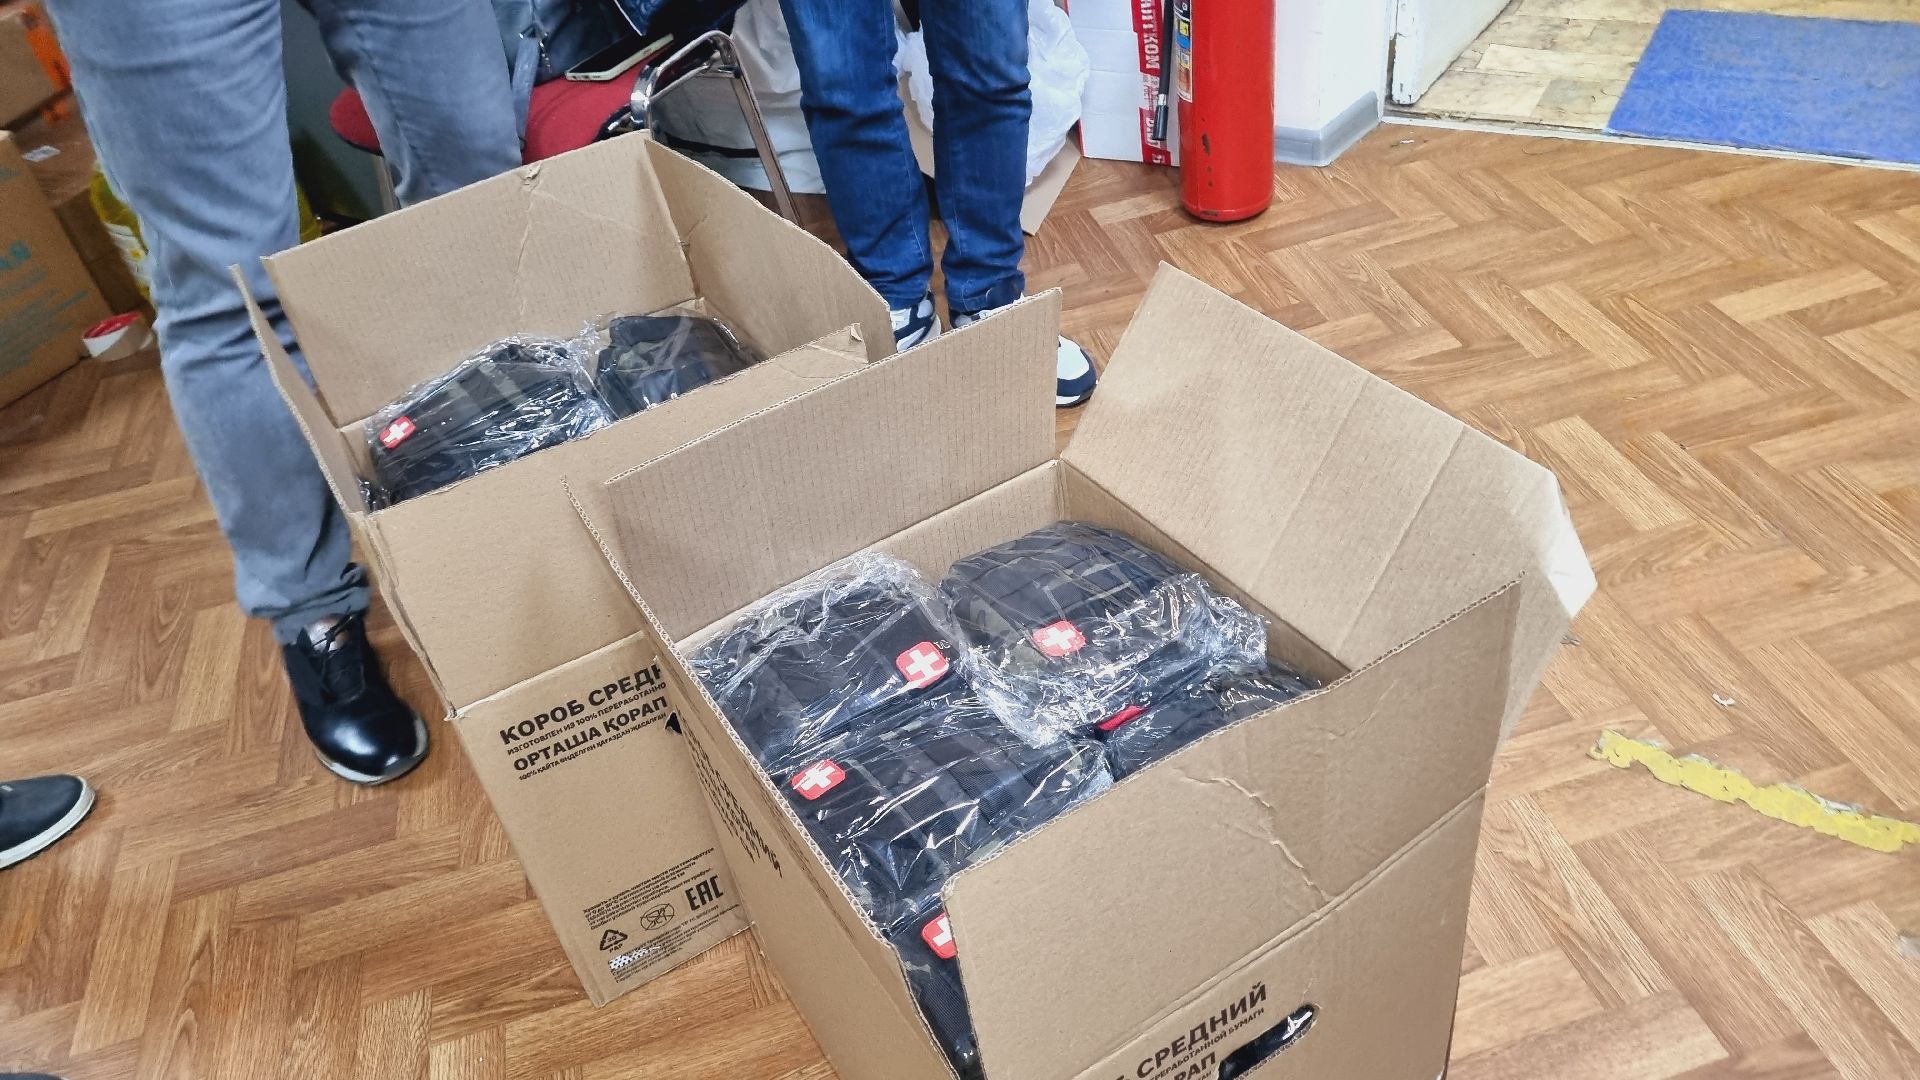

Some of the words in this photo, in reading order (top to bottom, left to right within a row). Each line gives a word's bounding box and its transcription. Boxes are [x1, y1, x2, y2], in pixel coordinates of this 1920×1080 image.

[500, 699, 585, 745] КОРОБ
[507, 728, 563, 755] ИЗГОТОВЛЕН
[563, 722, 575, 731] ИЗ
[575, 713, 597, 726] 100%
[514, 727, 602, 770] ОРТАША
[603, 696, 668, 733] ҚОРАП
[1137, 982, 1266, 1078] СРЕДНИЙ
[1228, 1007, 1264, 1034] БУМАГИ
